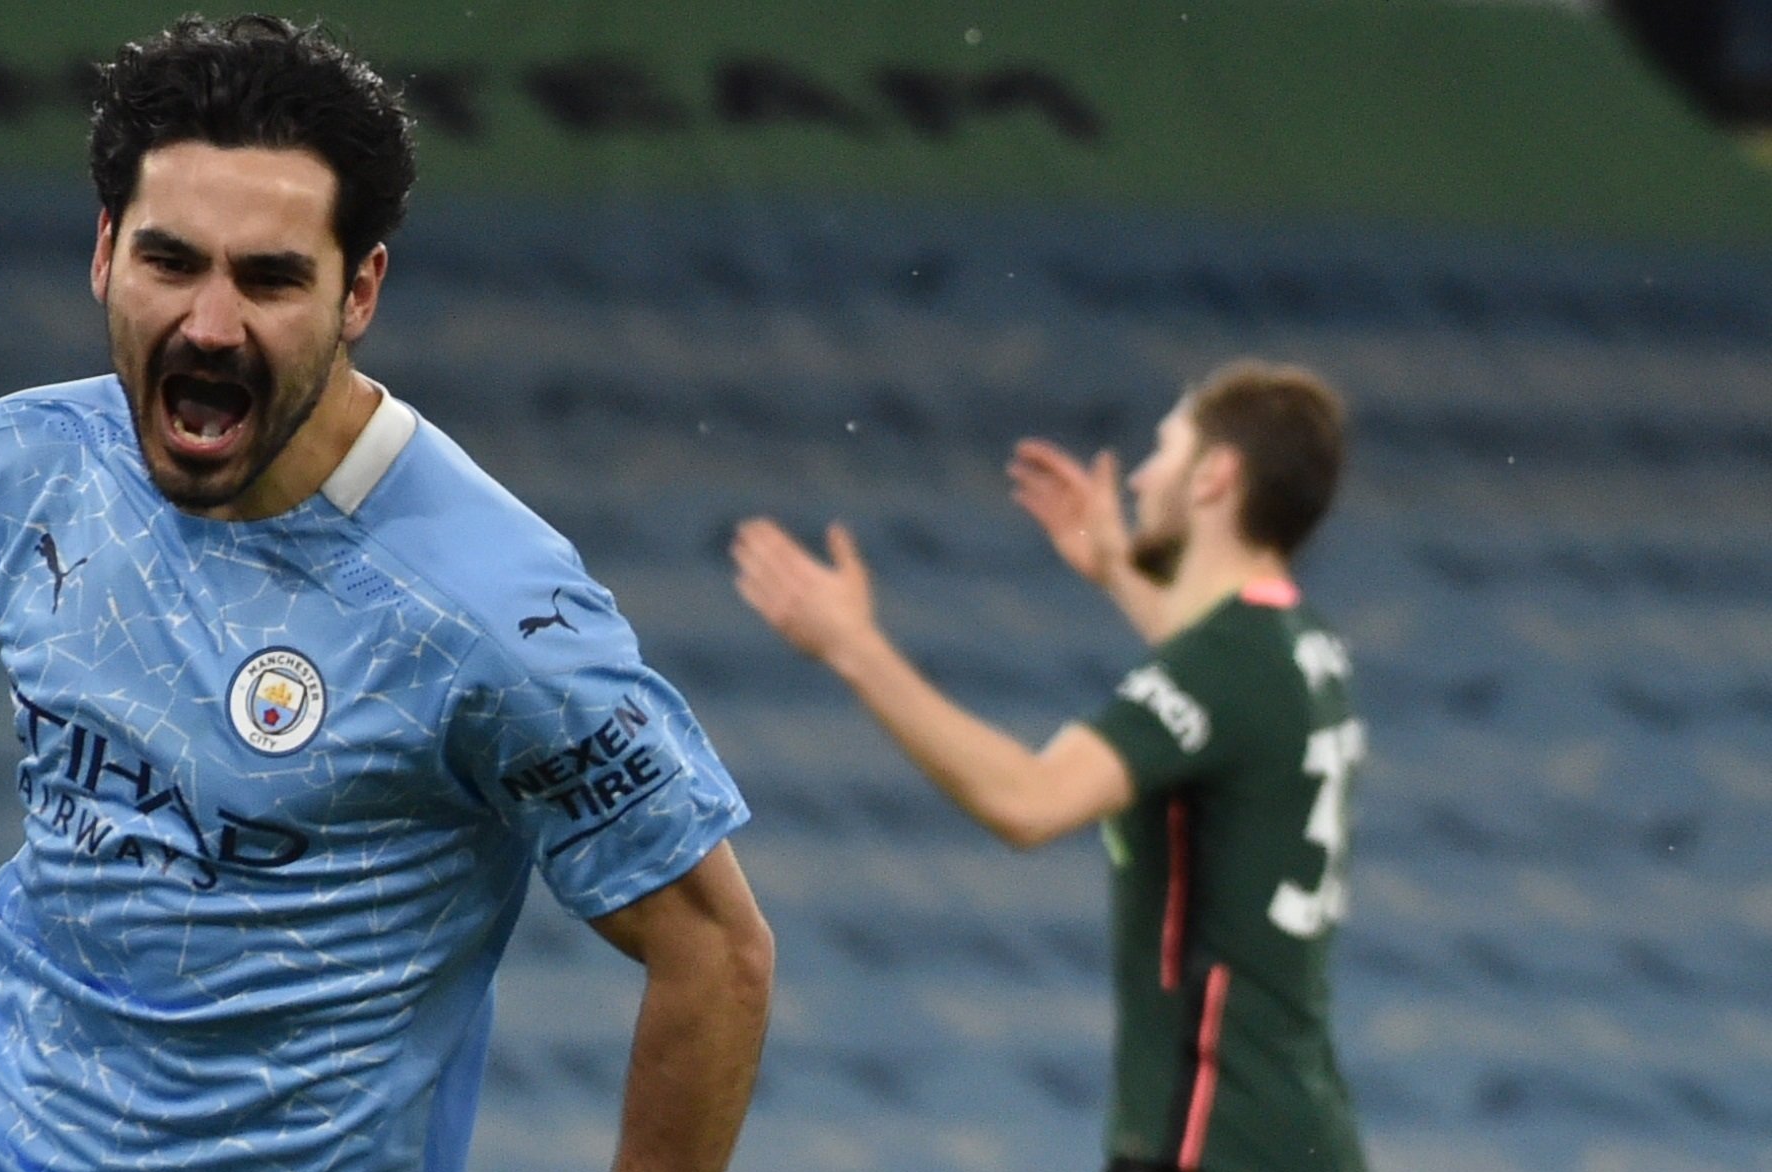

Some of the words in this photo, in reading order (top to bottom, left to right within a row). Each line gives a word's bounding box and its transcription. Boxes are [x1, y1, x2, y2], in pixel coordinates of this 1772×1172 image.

[248, 655, 319, 701] MANCHESTER
[13, 685, 309, 868] TIHAD
[249, 732, 277, 749] CITY
[499, 694, 649, 799] NEXEN
[544, 746, 661, 822] TIRE
